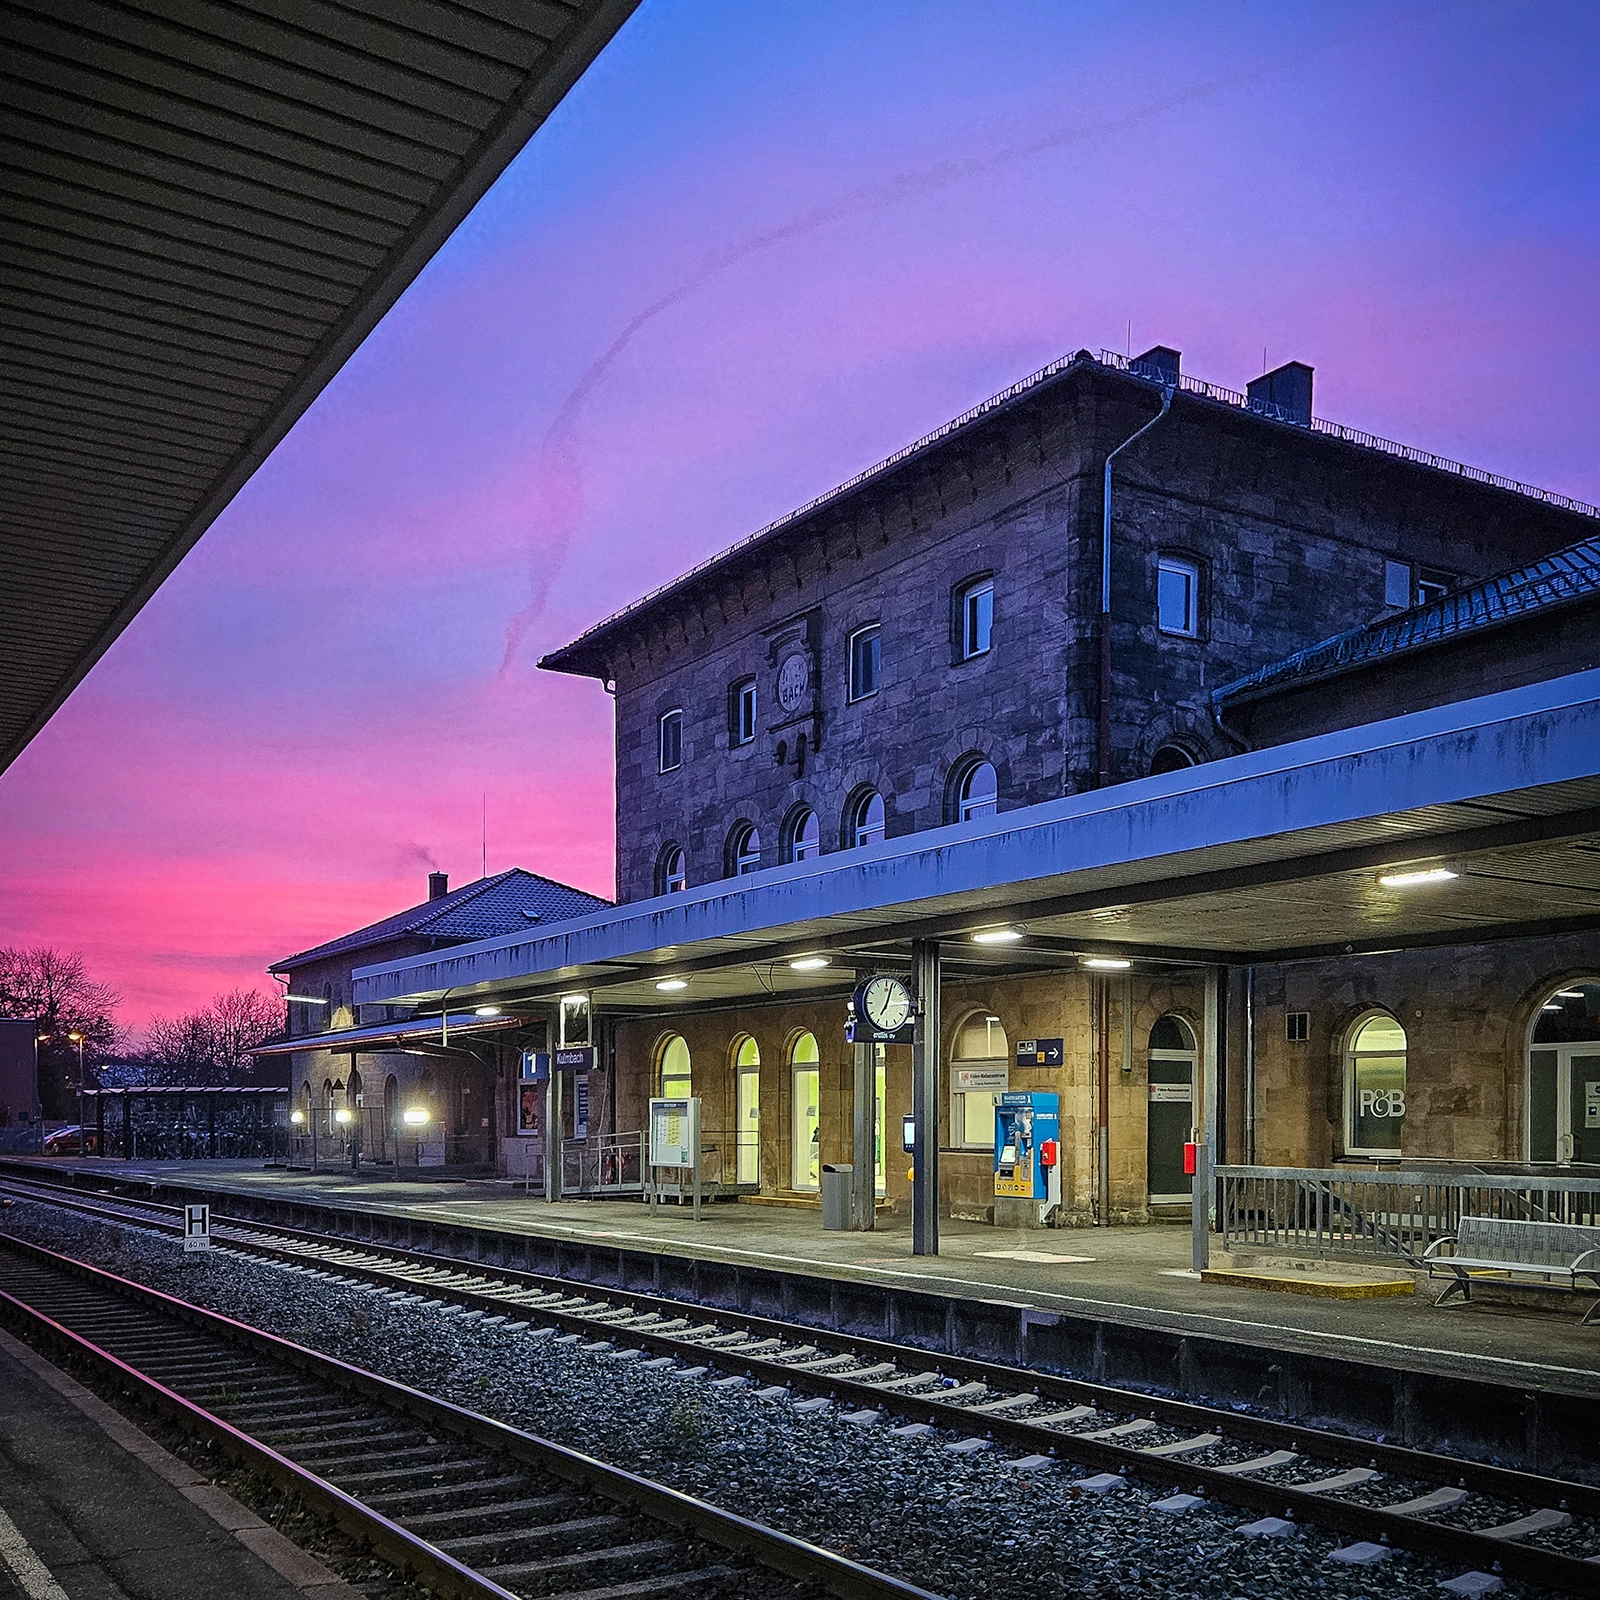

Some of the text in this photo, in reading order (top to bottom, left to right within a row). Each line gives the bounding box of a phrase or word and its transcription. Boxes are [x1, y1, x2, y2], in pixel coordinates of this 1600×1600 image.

[527, 1053, 537, 1074] 1
[556, 1051, 584, 1065] Kulmbach
[1360, 1089, 1406, 1118] P&B
[188, 1207, 207, 1235] H
[188, 1241, 198, 1249] 60
